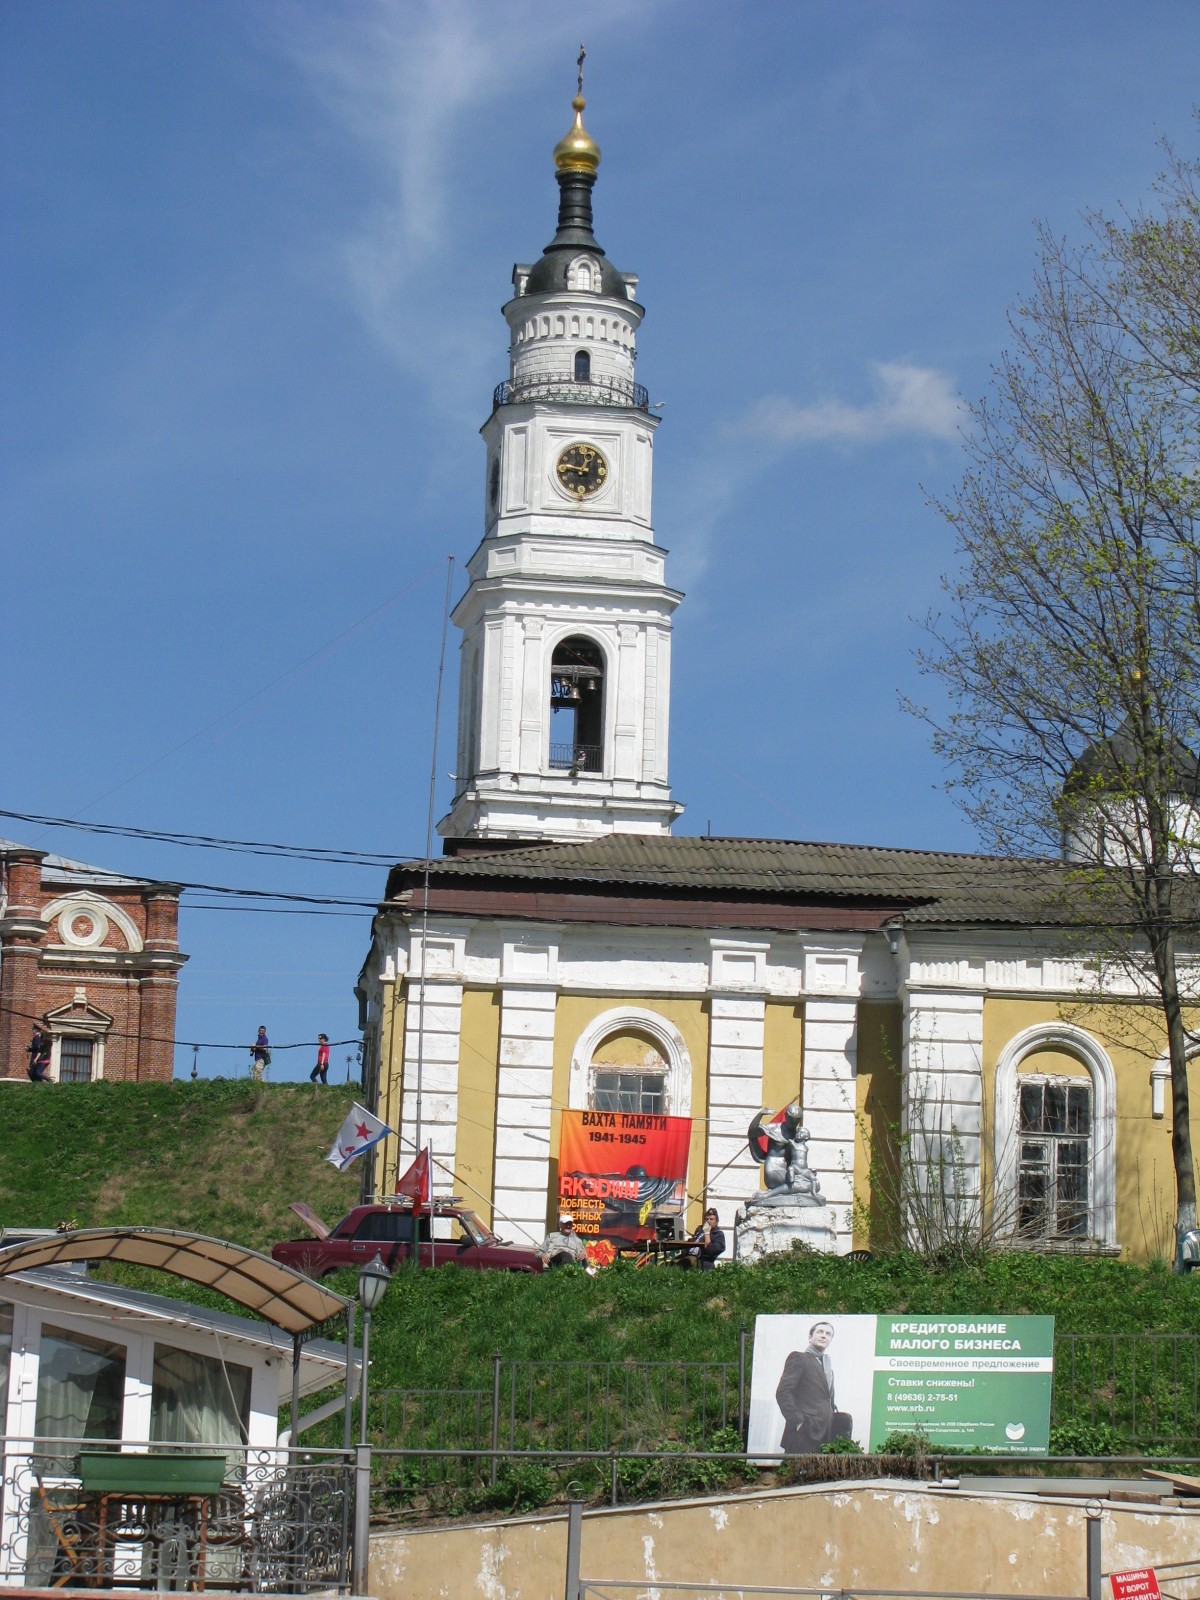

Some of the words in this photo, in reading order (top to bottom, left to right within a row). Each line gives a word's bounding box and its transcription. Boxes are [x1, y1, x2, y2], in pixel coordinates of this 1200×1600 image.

[582, 1112, 616, 1128] ВАХТА
[621, 1114, 667, 1131] ПАМЯТИ
[588, 1131, 647, 1145] 1941-1945
[560, 1197, 606, 1209] ДОБЛЕСТЬ
[571, 1223, 600, 1234] РЯКОВ
[891, 1323, 1006, 1335] КРЕДИТОВАНИЕ
[890, 1338, 950, 1350] МАЛОГО
[954, 1339, 1022, 1351] БИЗНЕСА
[889, 1358, 969, 1369] Своевременное
[972, 1359, 1040, 1369] предложение
[888, 1377, 924, 1387] Ставки
[926, 1378, 975, 1387] снижены!
[887, 1393, 892, 1401] 8
[894, 1393, 926, 1402] (49636)
[927, 1393, 959, 1402] 2-75-51
[1116, 1572, 1148, 1583] МАШИНЫ
[1126, 1583, 1148, 1593] ВОРОТ
